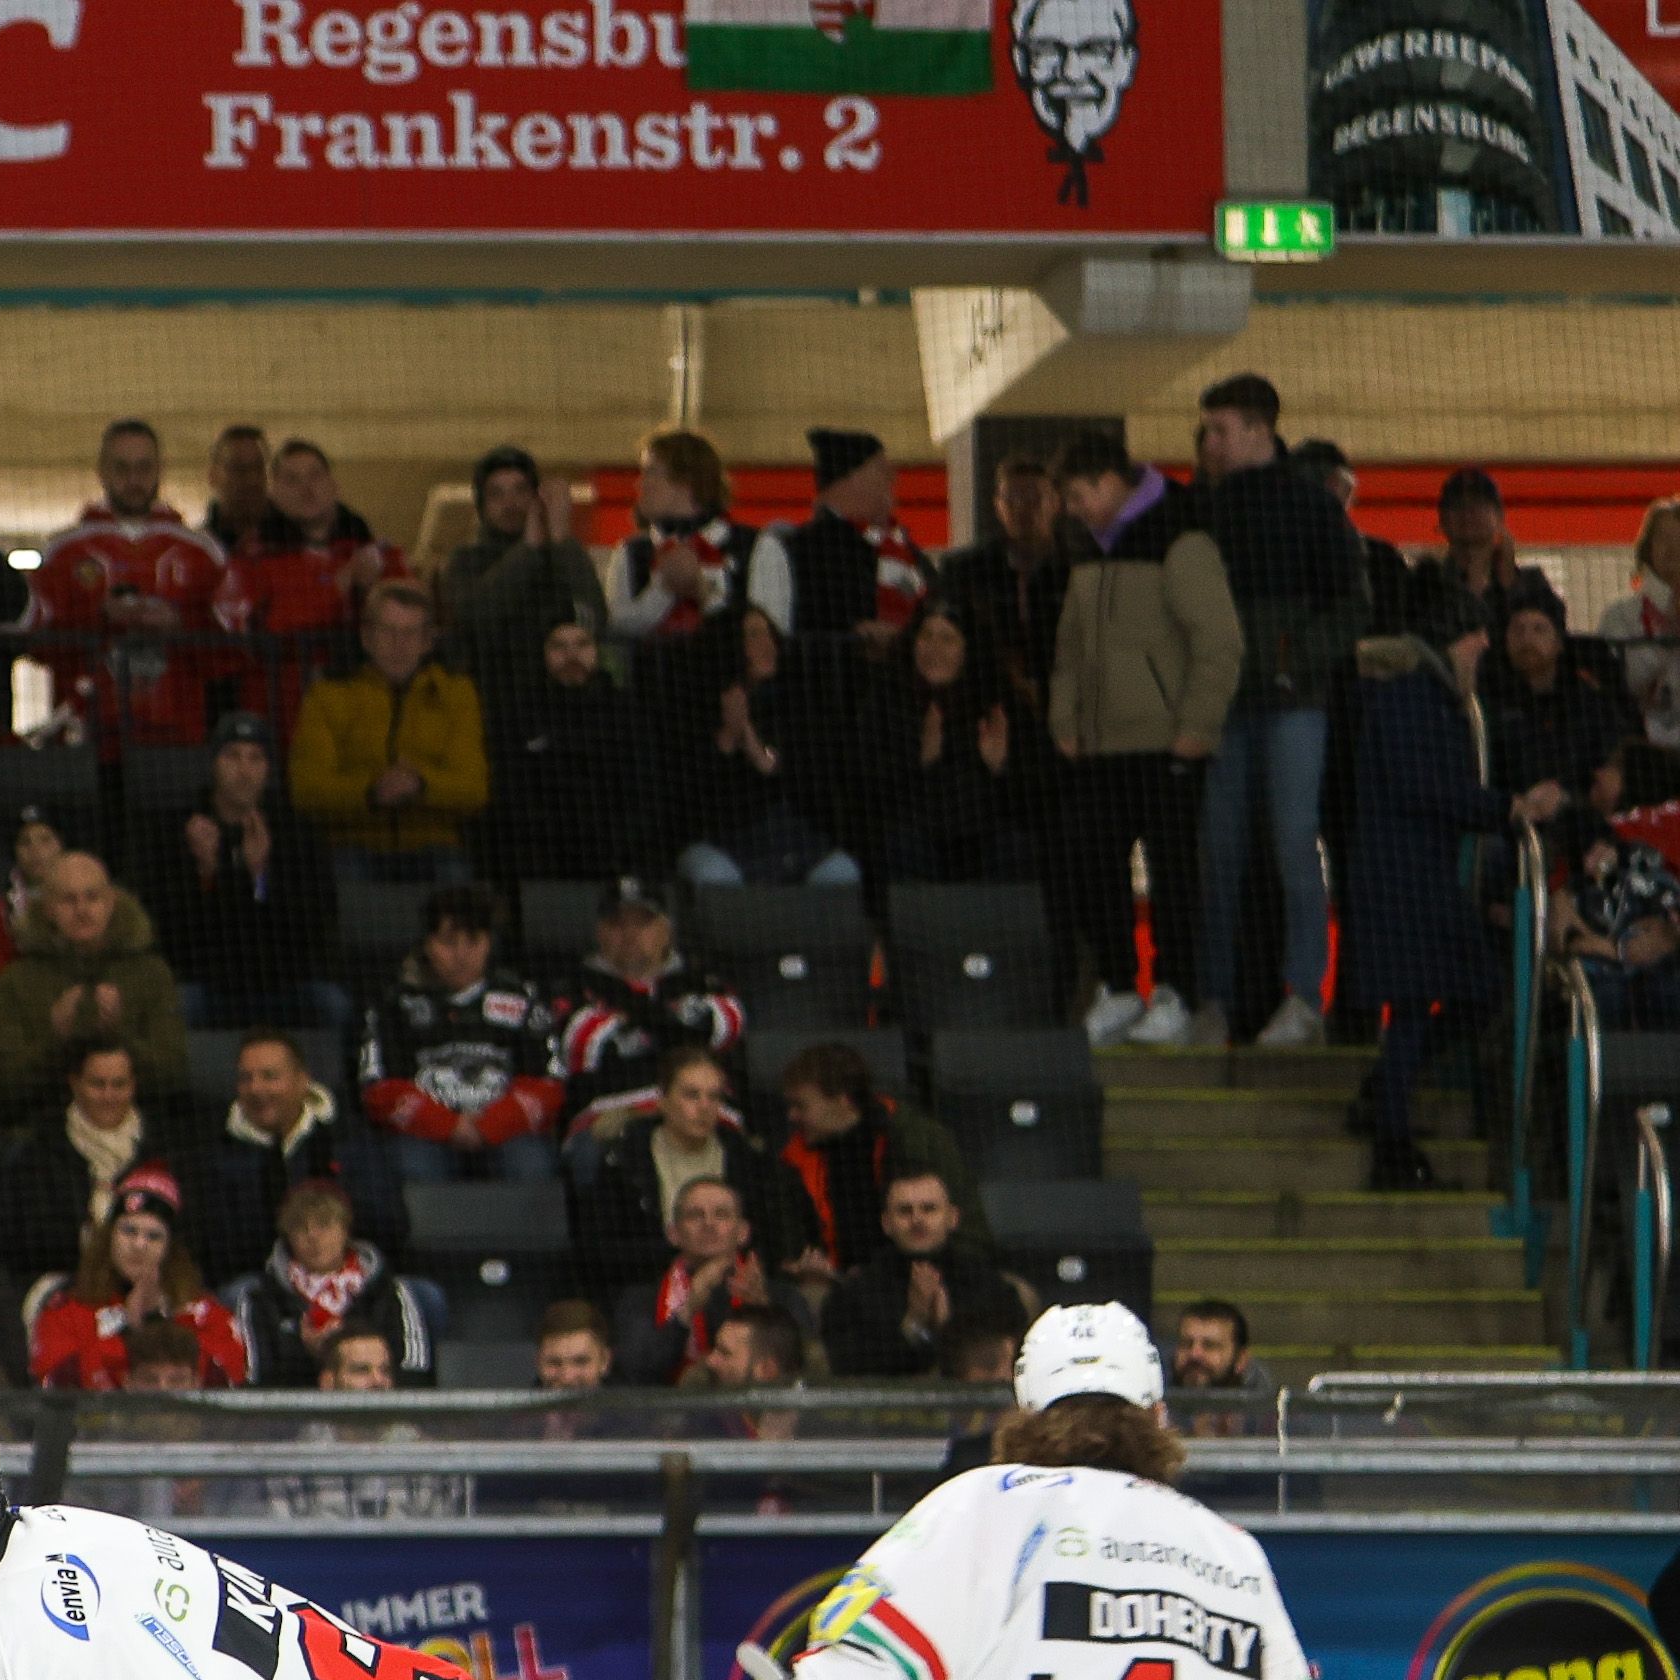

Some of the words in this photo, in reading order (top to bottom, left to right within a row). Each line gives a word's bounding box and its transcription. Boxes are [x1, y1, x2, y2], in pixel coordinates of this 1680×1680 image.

[233, 0, 690, 83] Regensbu
[202, 92, 801, 170] Frankenstr.
[822, 96, 883, 171] 2
[52, 1568, 87, 1623] envia
